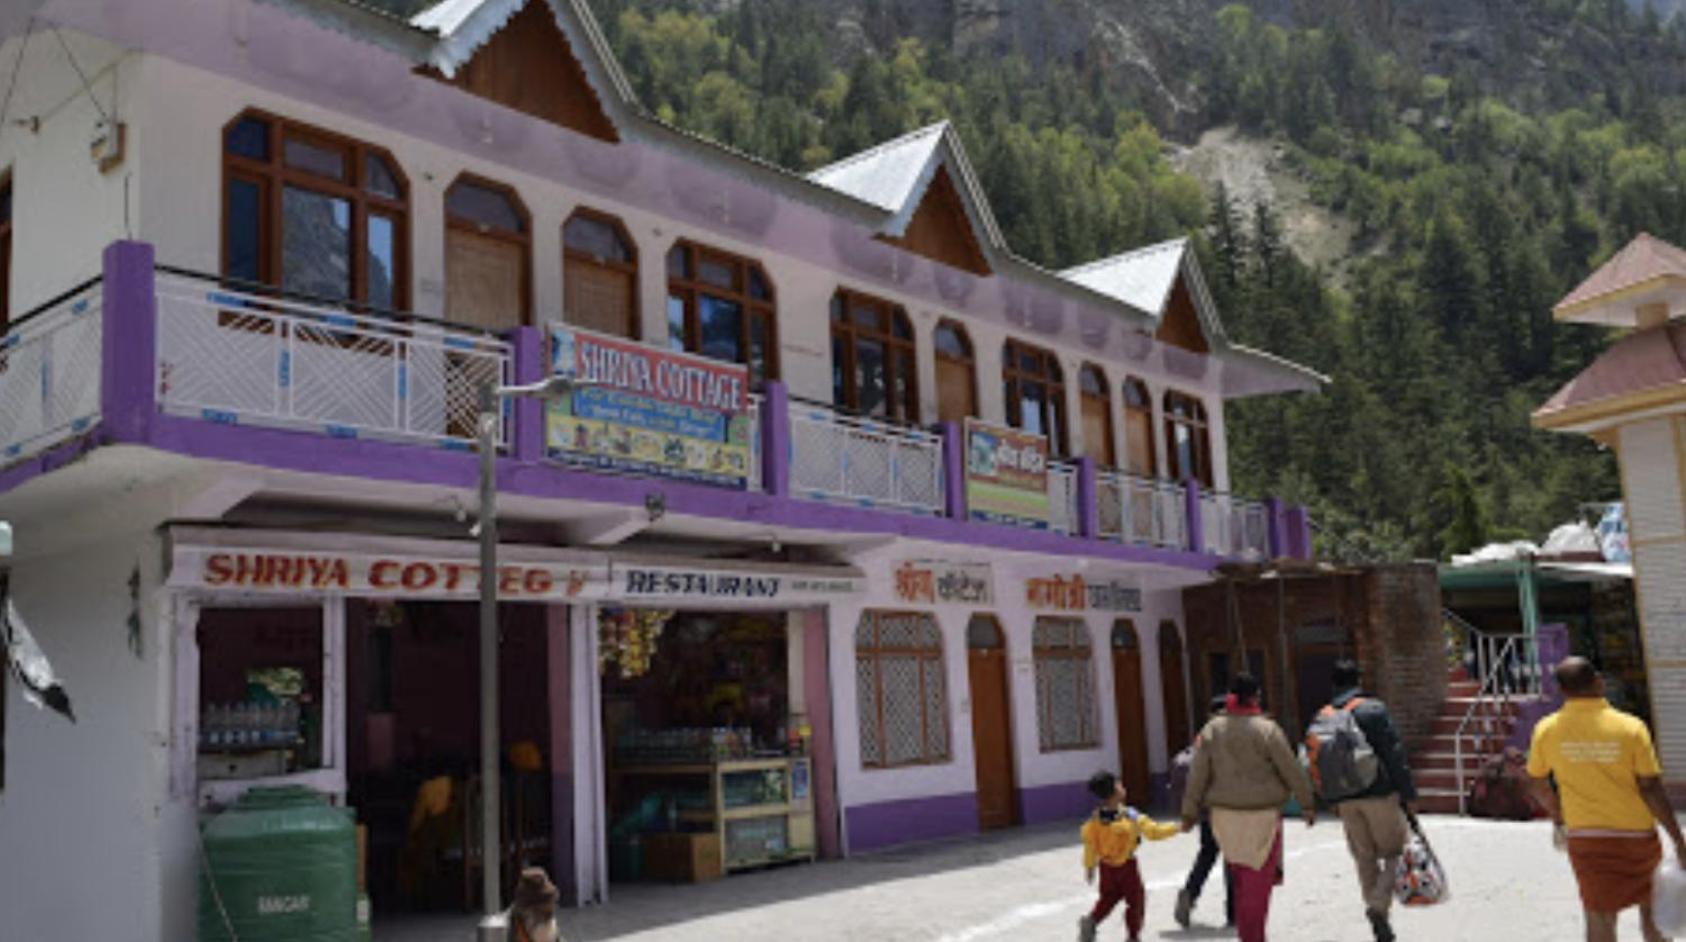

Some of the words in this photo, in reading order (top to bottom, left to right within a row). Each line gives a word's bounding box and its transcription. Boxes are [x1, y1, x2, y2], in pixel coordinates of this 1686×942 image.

[580, 341, 654, 393] SHRIYA
[656, 358, 742, 410] COTTAGE
[203, 554, 350, 588] SHRIYA
[625, 569, 782, 598] RESTAURANT
